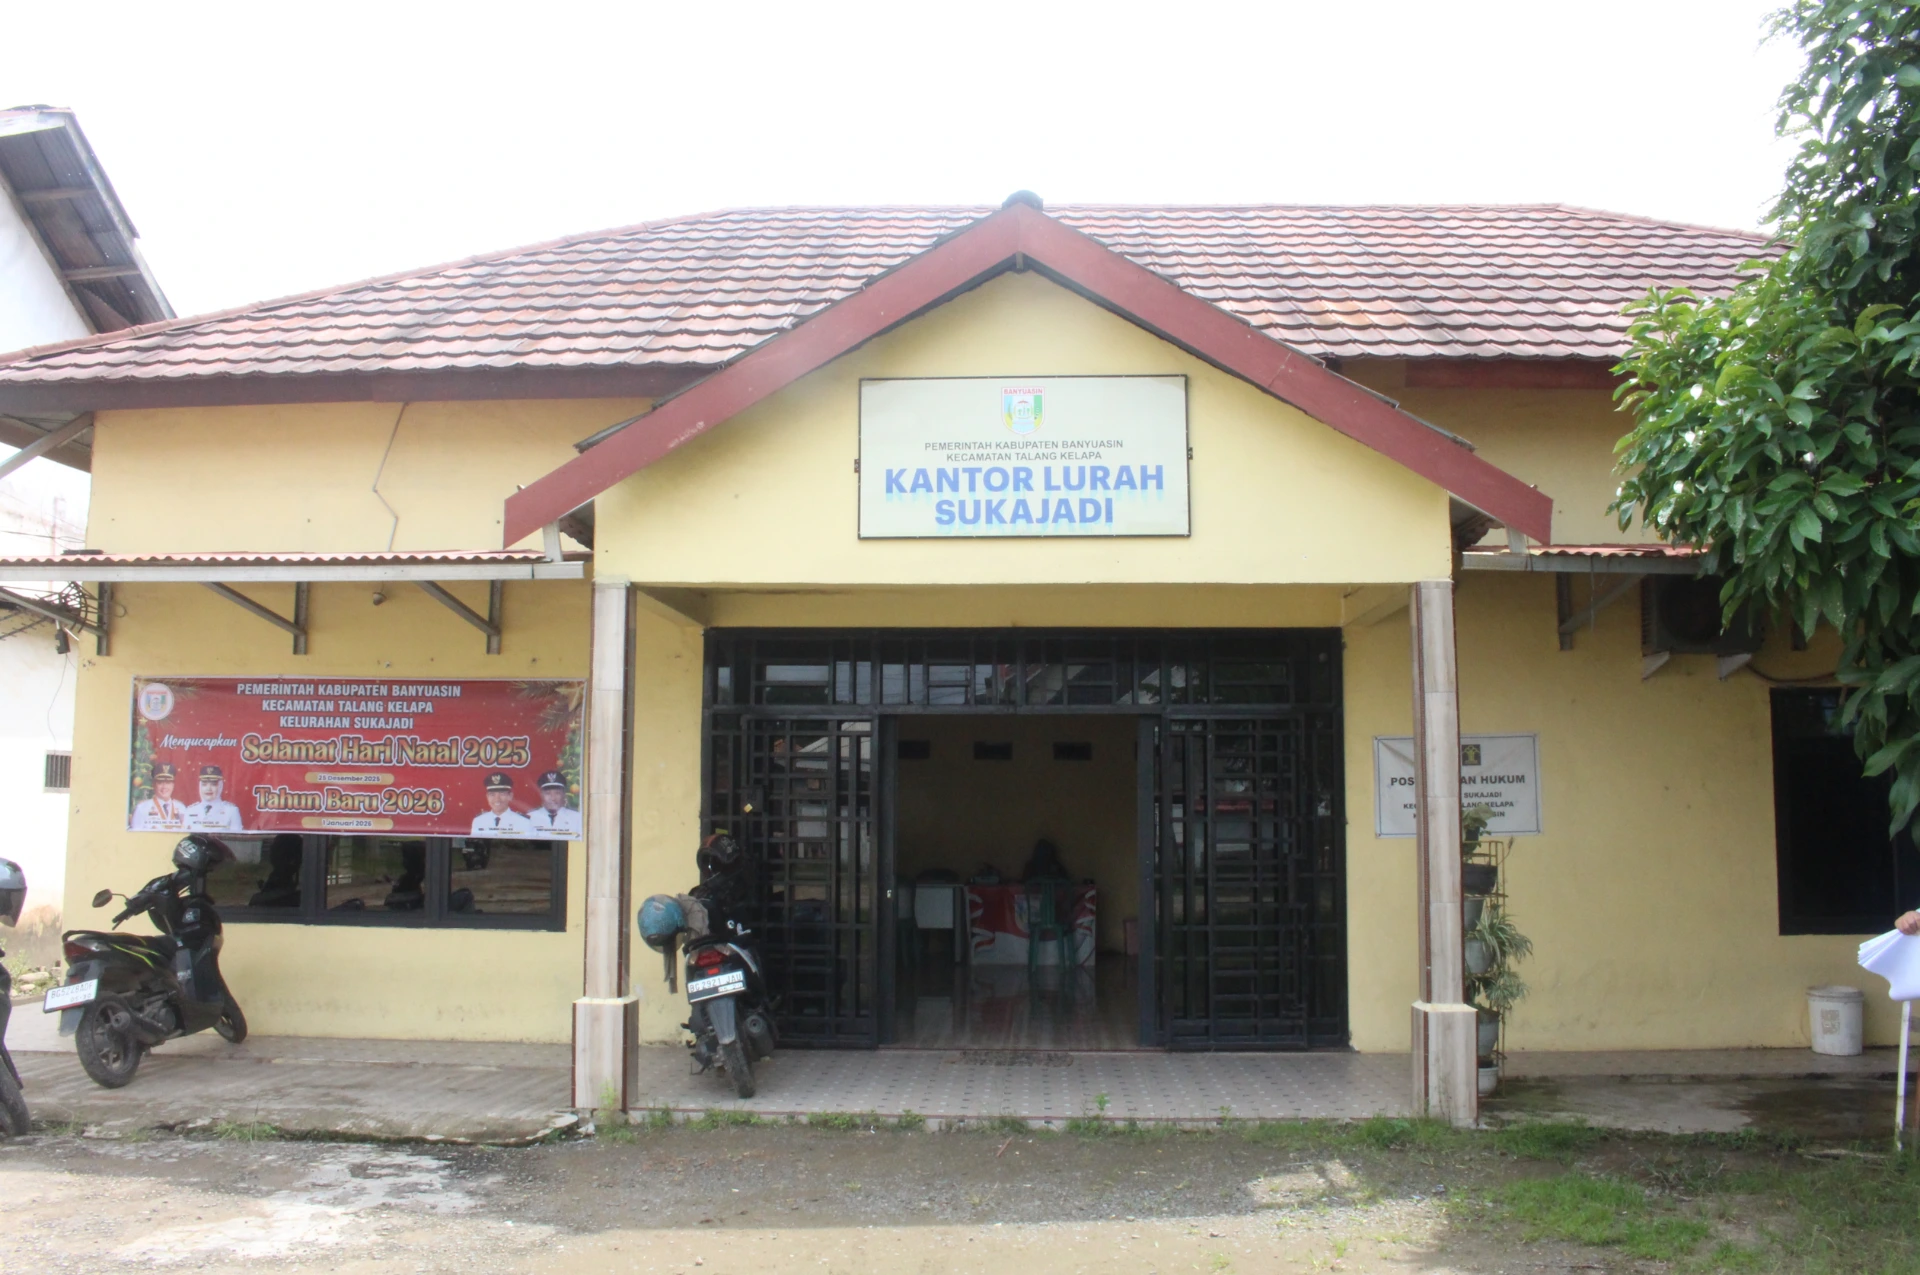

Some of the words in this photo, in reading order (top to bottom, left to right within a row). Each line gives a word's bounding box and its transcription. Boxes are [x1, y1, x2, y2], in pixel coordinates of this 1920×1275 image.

[925, 442, 992, 451] PEMERINTAH
[995, 441, 1059, 450] KABUPATEN
[1062, 440, 1124, 449] BANYUASIN
[946, 452, 1012, 462] KECAMATAN
[1015, 452, 1057, 461] TALANG
[1060, 451, 1102, 460] KELAPA
[885, 467, 1034, 494] KANTOR
[1044, 465, 1164, 491] LURAH
[935, 498, 1114, 525] SUKAJADI
[237, 683, 314, 695] PEMERINTAH
[318, 684, 388, 696] KABUPATEN
[392, 685, 461, 697] BANYUASIN
[262, 700, 334, 712] KECAMATAN
[338, 701, 384, 713] TALANG
[387, 701, 434, 713] KELAPA
[280, 716, 350, 728] KELURAHAN
[354, 717, 414, 729] SUKAJADI
[160, 733, 238, 750] Mengucapkan
[242, 734, 338, 763] Selamat
[340, 736, 393, 764] Hari
[397, 737, 459, 766] Natal
[463, 737, 529, 767] 2025
[1391, 777, 1415, 786] POS
[1481, 775, 1525, 784] HUKUM
[254, 785, 322, 811] Tahun
[325, 787, 379, 813] Baru
[382, 788, 444, 815] 2026
